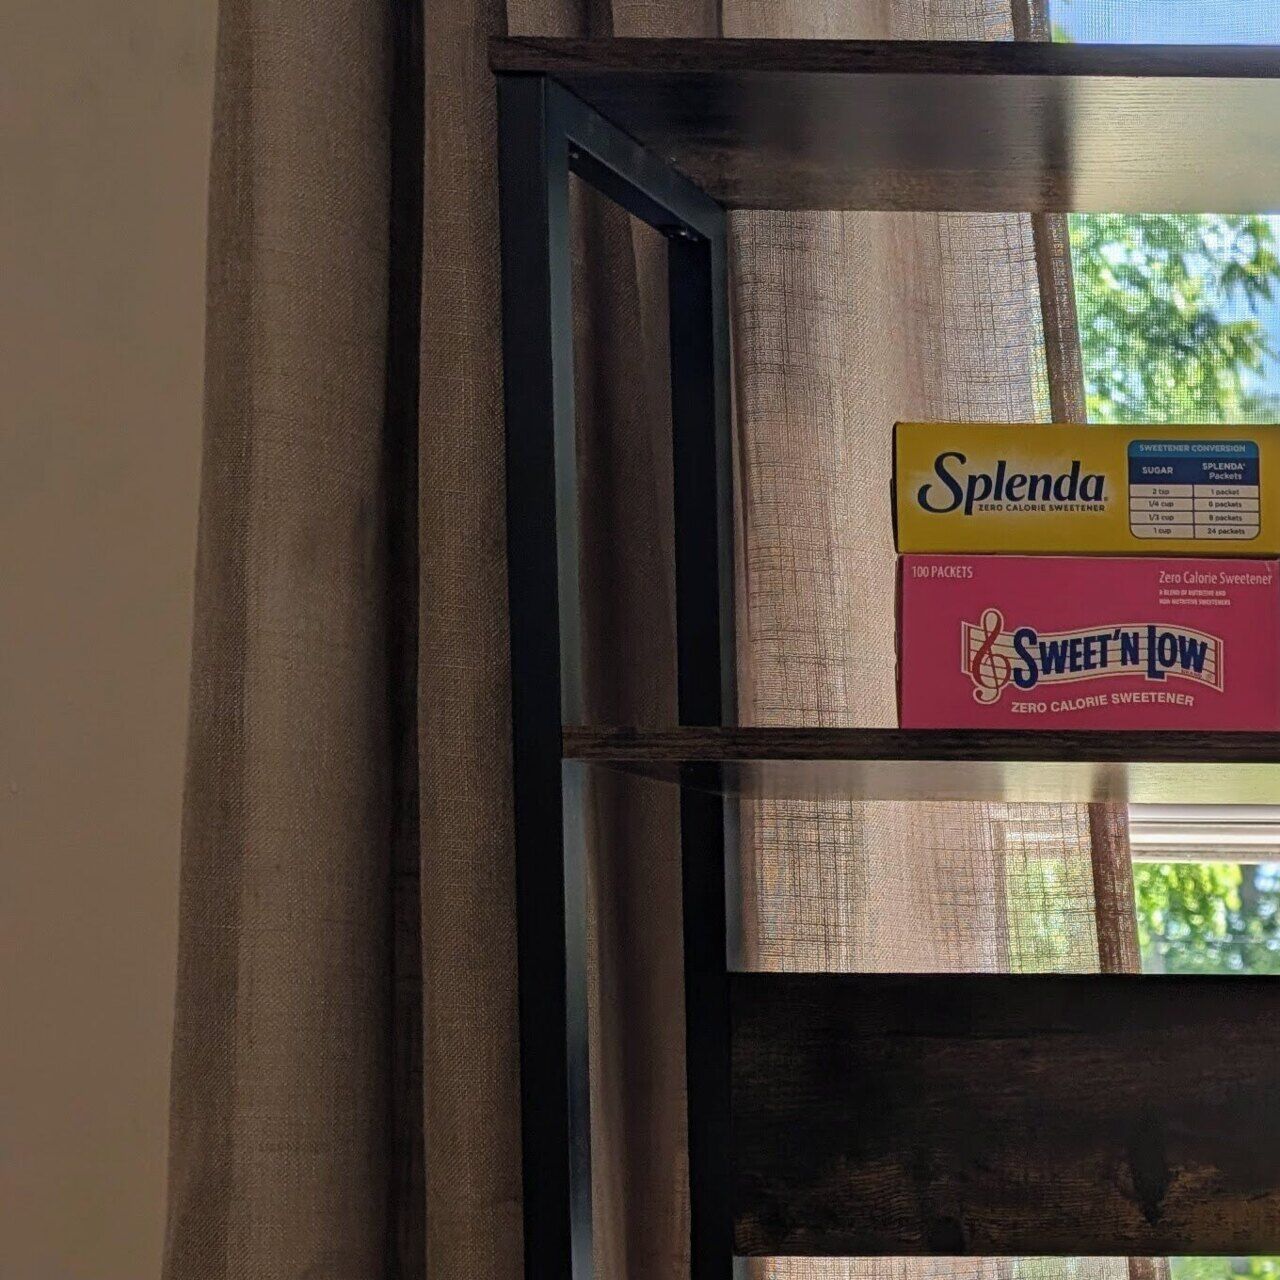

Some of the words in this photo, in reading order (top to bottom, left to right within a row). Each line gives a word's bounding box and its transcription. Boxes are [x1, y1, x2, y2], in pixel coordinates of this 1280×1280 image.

[1139, 444, 1189, 452] SWEETENER
[1191, 444, 1246, 452] CONVERSION
[1142, 466, 1174, 474] SUGAR
[1208, 472, 1242, 480] Packets
[917, 451, 1106, 516] Splenda
[1216, 488, 1240, 496] packet
[978, 503, 1003, 512] ZERO
[1005, 503, 1046, 512] CALORIE
[1049, 503, 1106, 512] SWEETENER
[1215, 500, 1242, 508] packets
[1215, 514, 1242, 522] packets
[1218, 527, 1245, 535] packets
[911, 566, 929, 578] 100
[931, 565, 973, 579] PACKETS
[1159, 570, 1181, 584] Zero
[1183, 571, 1217, 584] Calorie
[1220, 571, 1272, 585] Sweetener
[1013, 628, 1140, 688] SWEET'N
[1147, 625, 1208, 680] LOW
[1011, 701, 1047, 713] ZERO
[1050, 694, 1108, 713] CALORIE
[1111, 692, 1194, 707] SWEETENER
